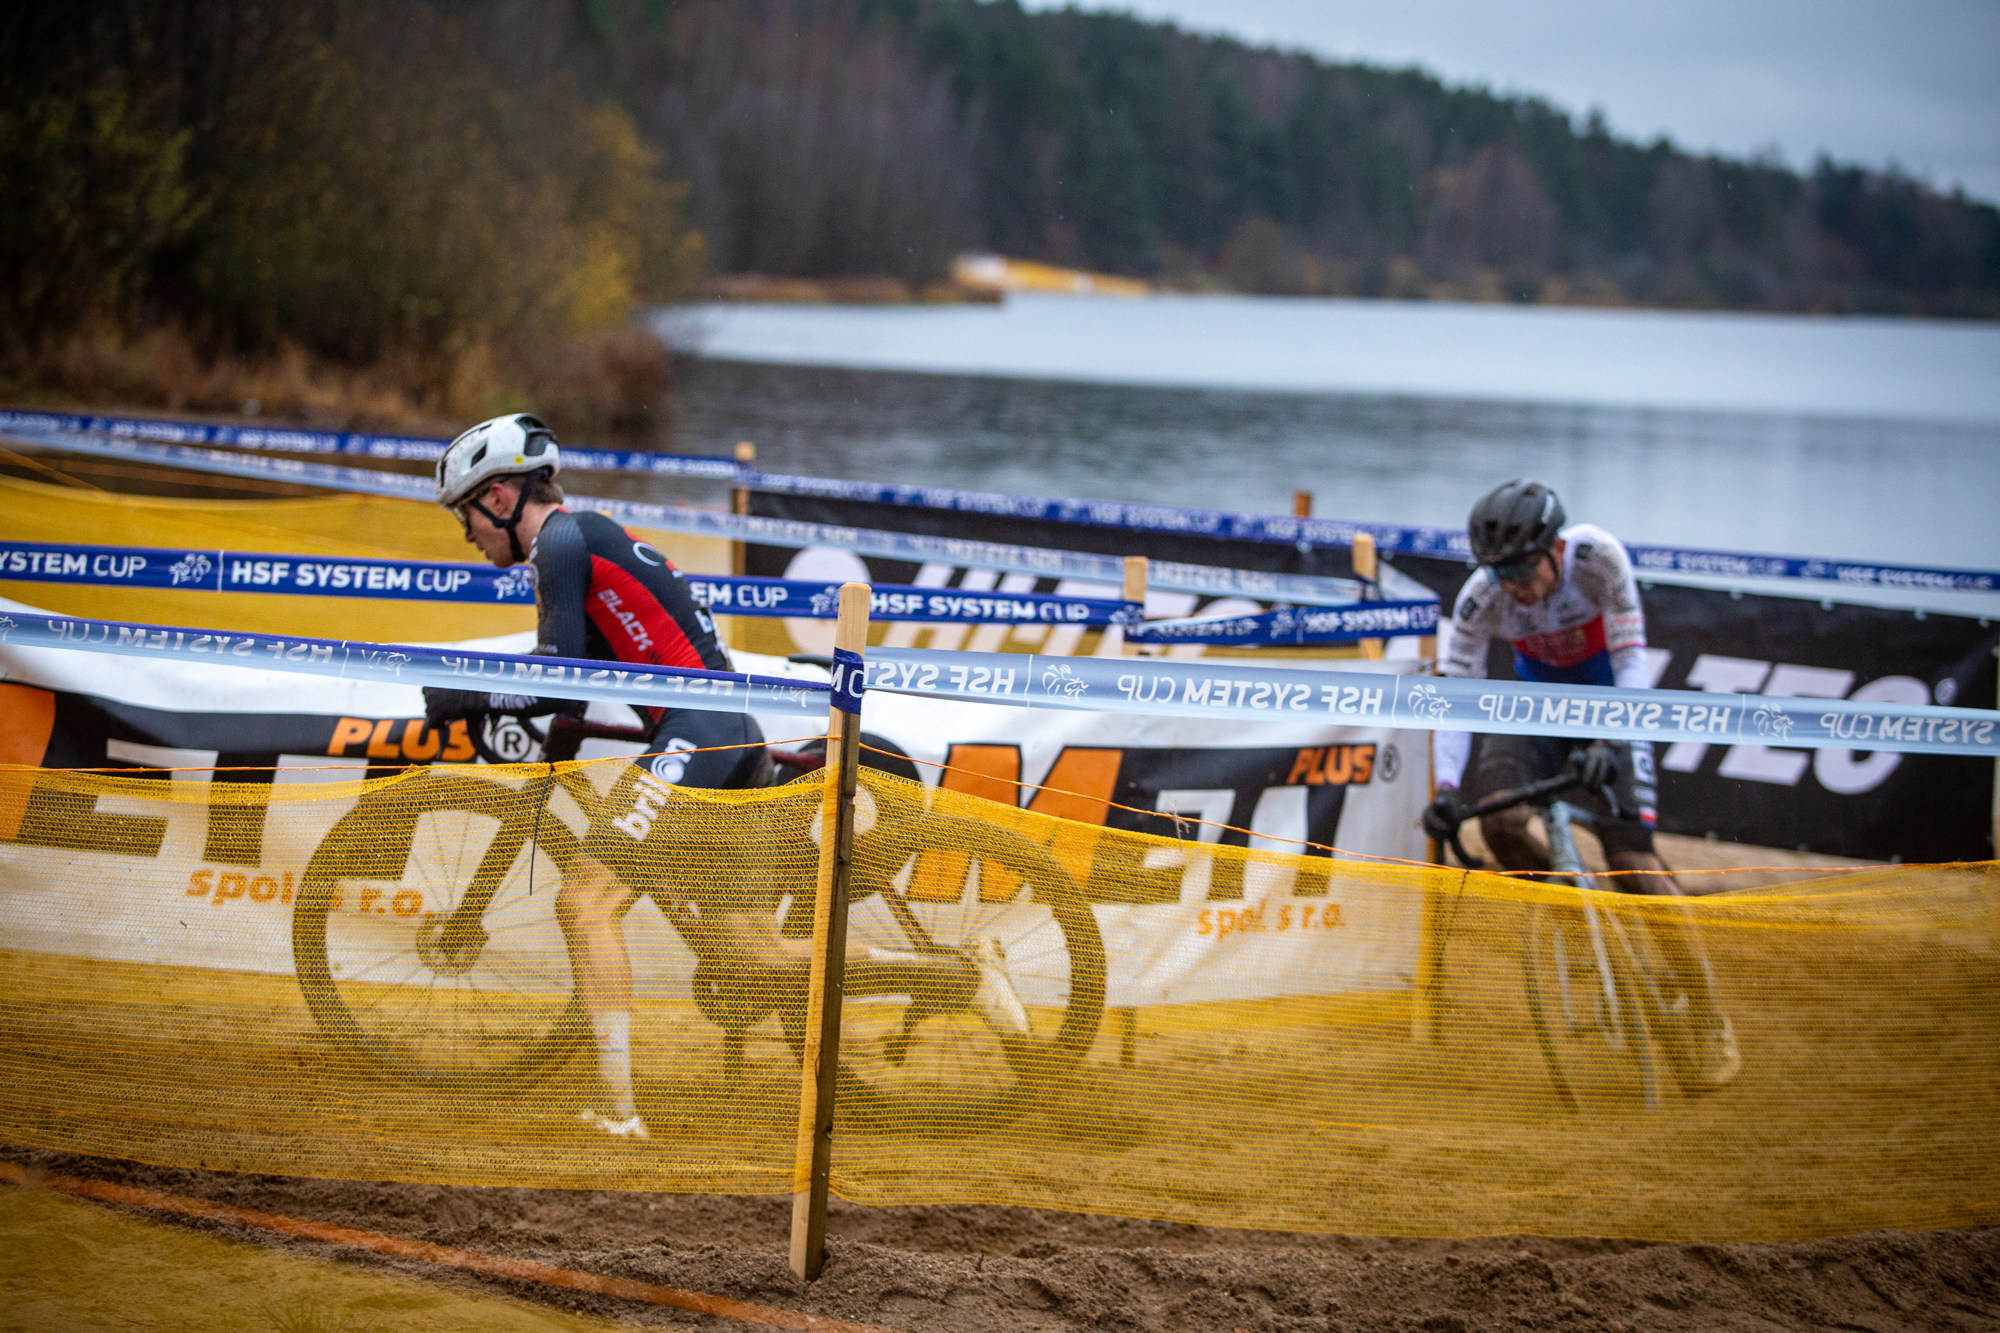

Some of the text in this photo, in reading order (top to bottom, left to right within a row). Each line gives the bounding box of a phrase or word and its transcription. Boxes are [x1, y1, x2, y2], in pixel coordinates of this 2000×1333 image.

[93, 554, 147, 578] CUP
[230, 560, 471, 592] HSF SYSTEM CUP
[737, 585, 788, 608] CUP
[869, 592, 1090, 621] HSF SYSTEM CUP
[597, 588, 653, 652] BLACK
[1345, 607, 1408, 631] SYSTEM
[326, 716, 477, 762] PLUS
[1286, 745, 1376, 786] PLUS
